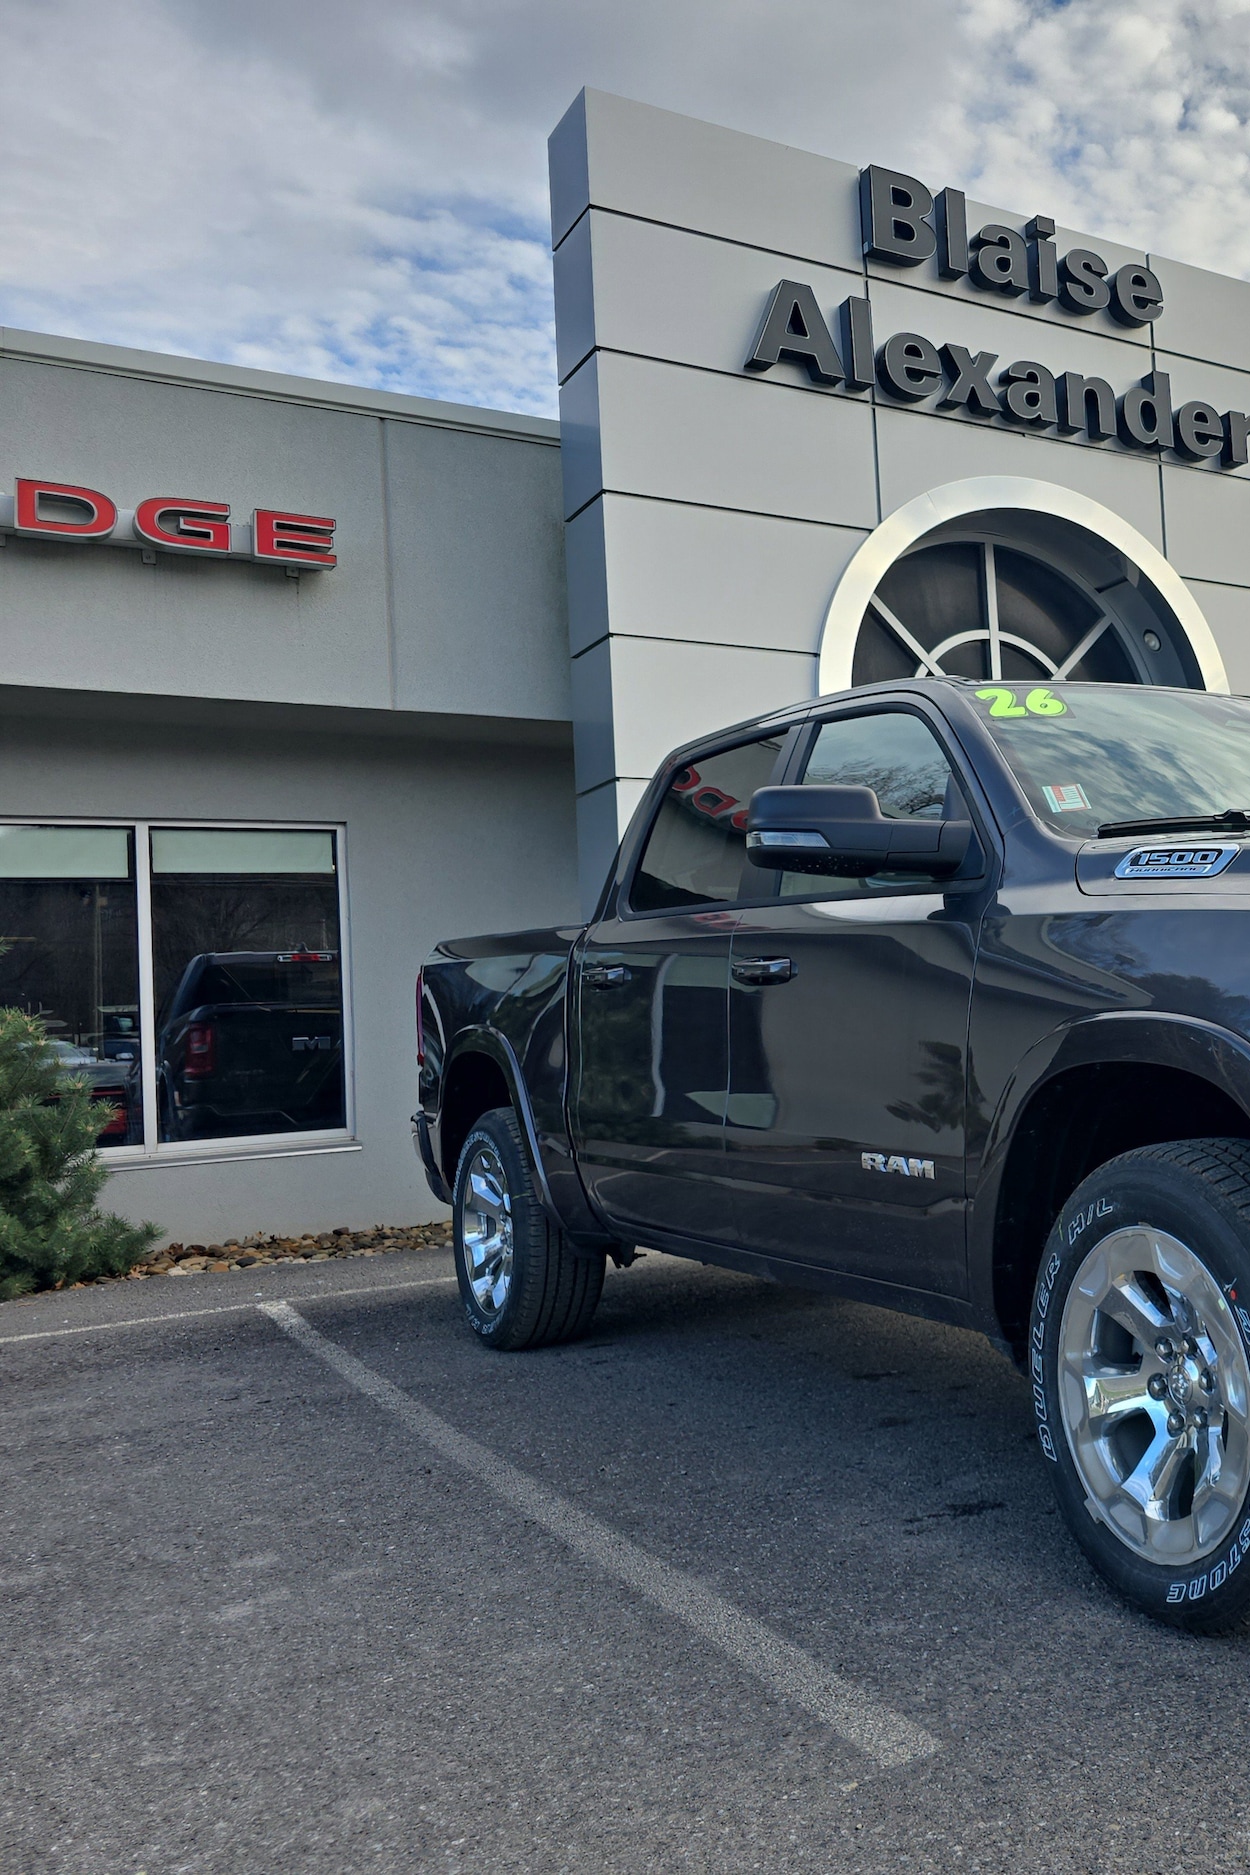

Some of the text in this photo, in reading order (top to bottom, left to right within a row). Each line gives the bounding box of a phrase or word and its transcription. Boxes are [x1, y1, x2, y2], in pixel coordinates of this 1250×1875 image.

[861, 164, 1164, 329] Blaise
[974, 688, 1068, 718] 26
[1138, 851, 1218, 865] 1500
[861, 1151, 936, 1180] RAM
[1031, 1252, 1062, 1462] DUELER
